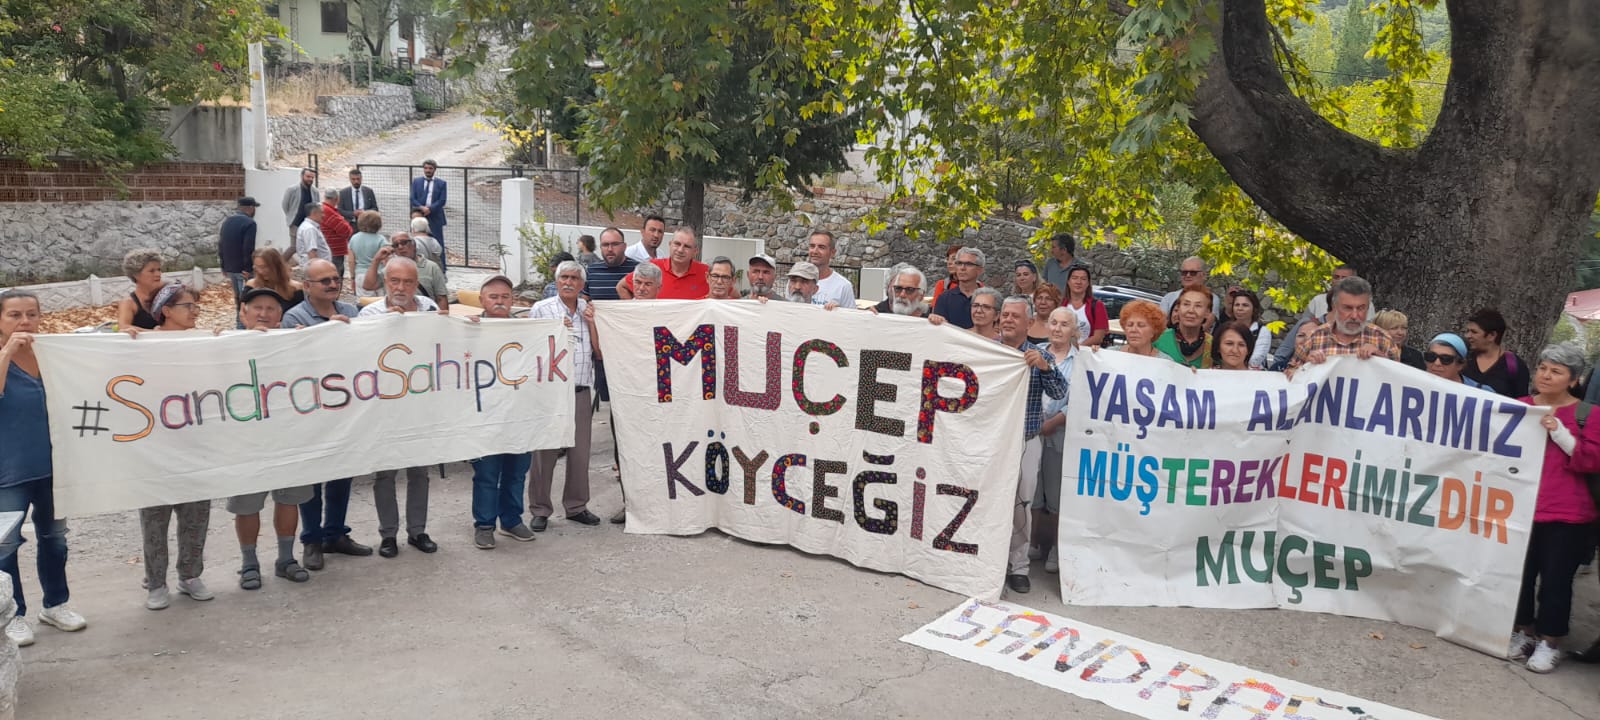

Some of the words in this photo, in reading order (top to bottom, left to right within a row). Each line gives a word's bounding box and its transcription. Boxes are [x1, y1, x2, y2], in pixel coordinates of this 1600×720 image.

[653, 324, 980, 444] MUÇEP
[1085, 370, 1216, 439] YAŞAM
[1247, 376, 1527, 459] ALANLARIMIZ
[1076, 443, 1515, 545] MÜŞTEREKLERİMİZDİR
[1195, 530, 1373, 604] MUÇEP
